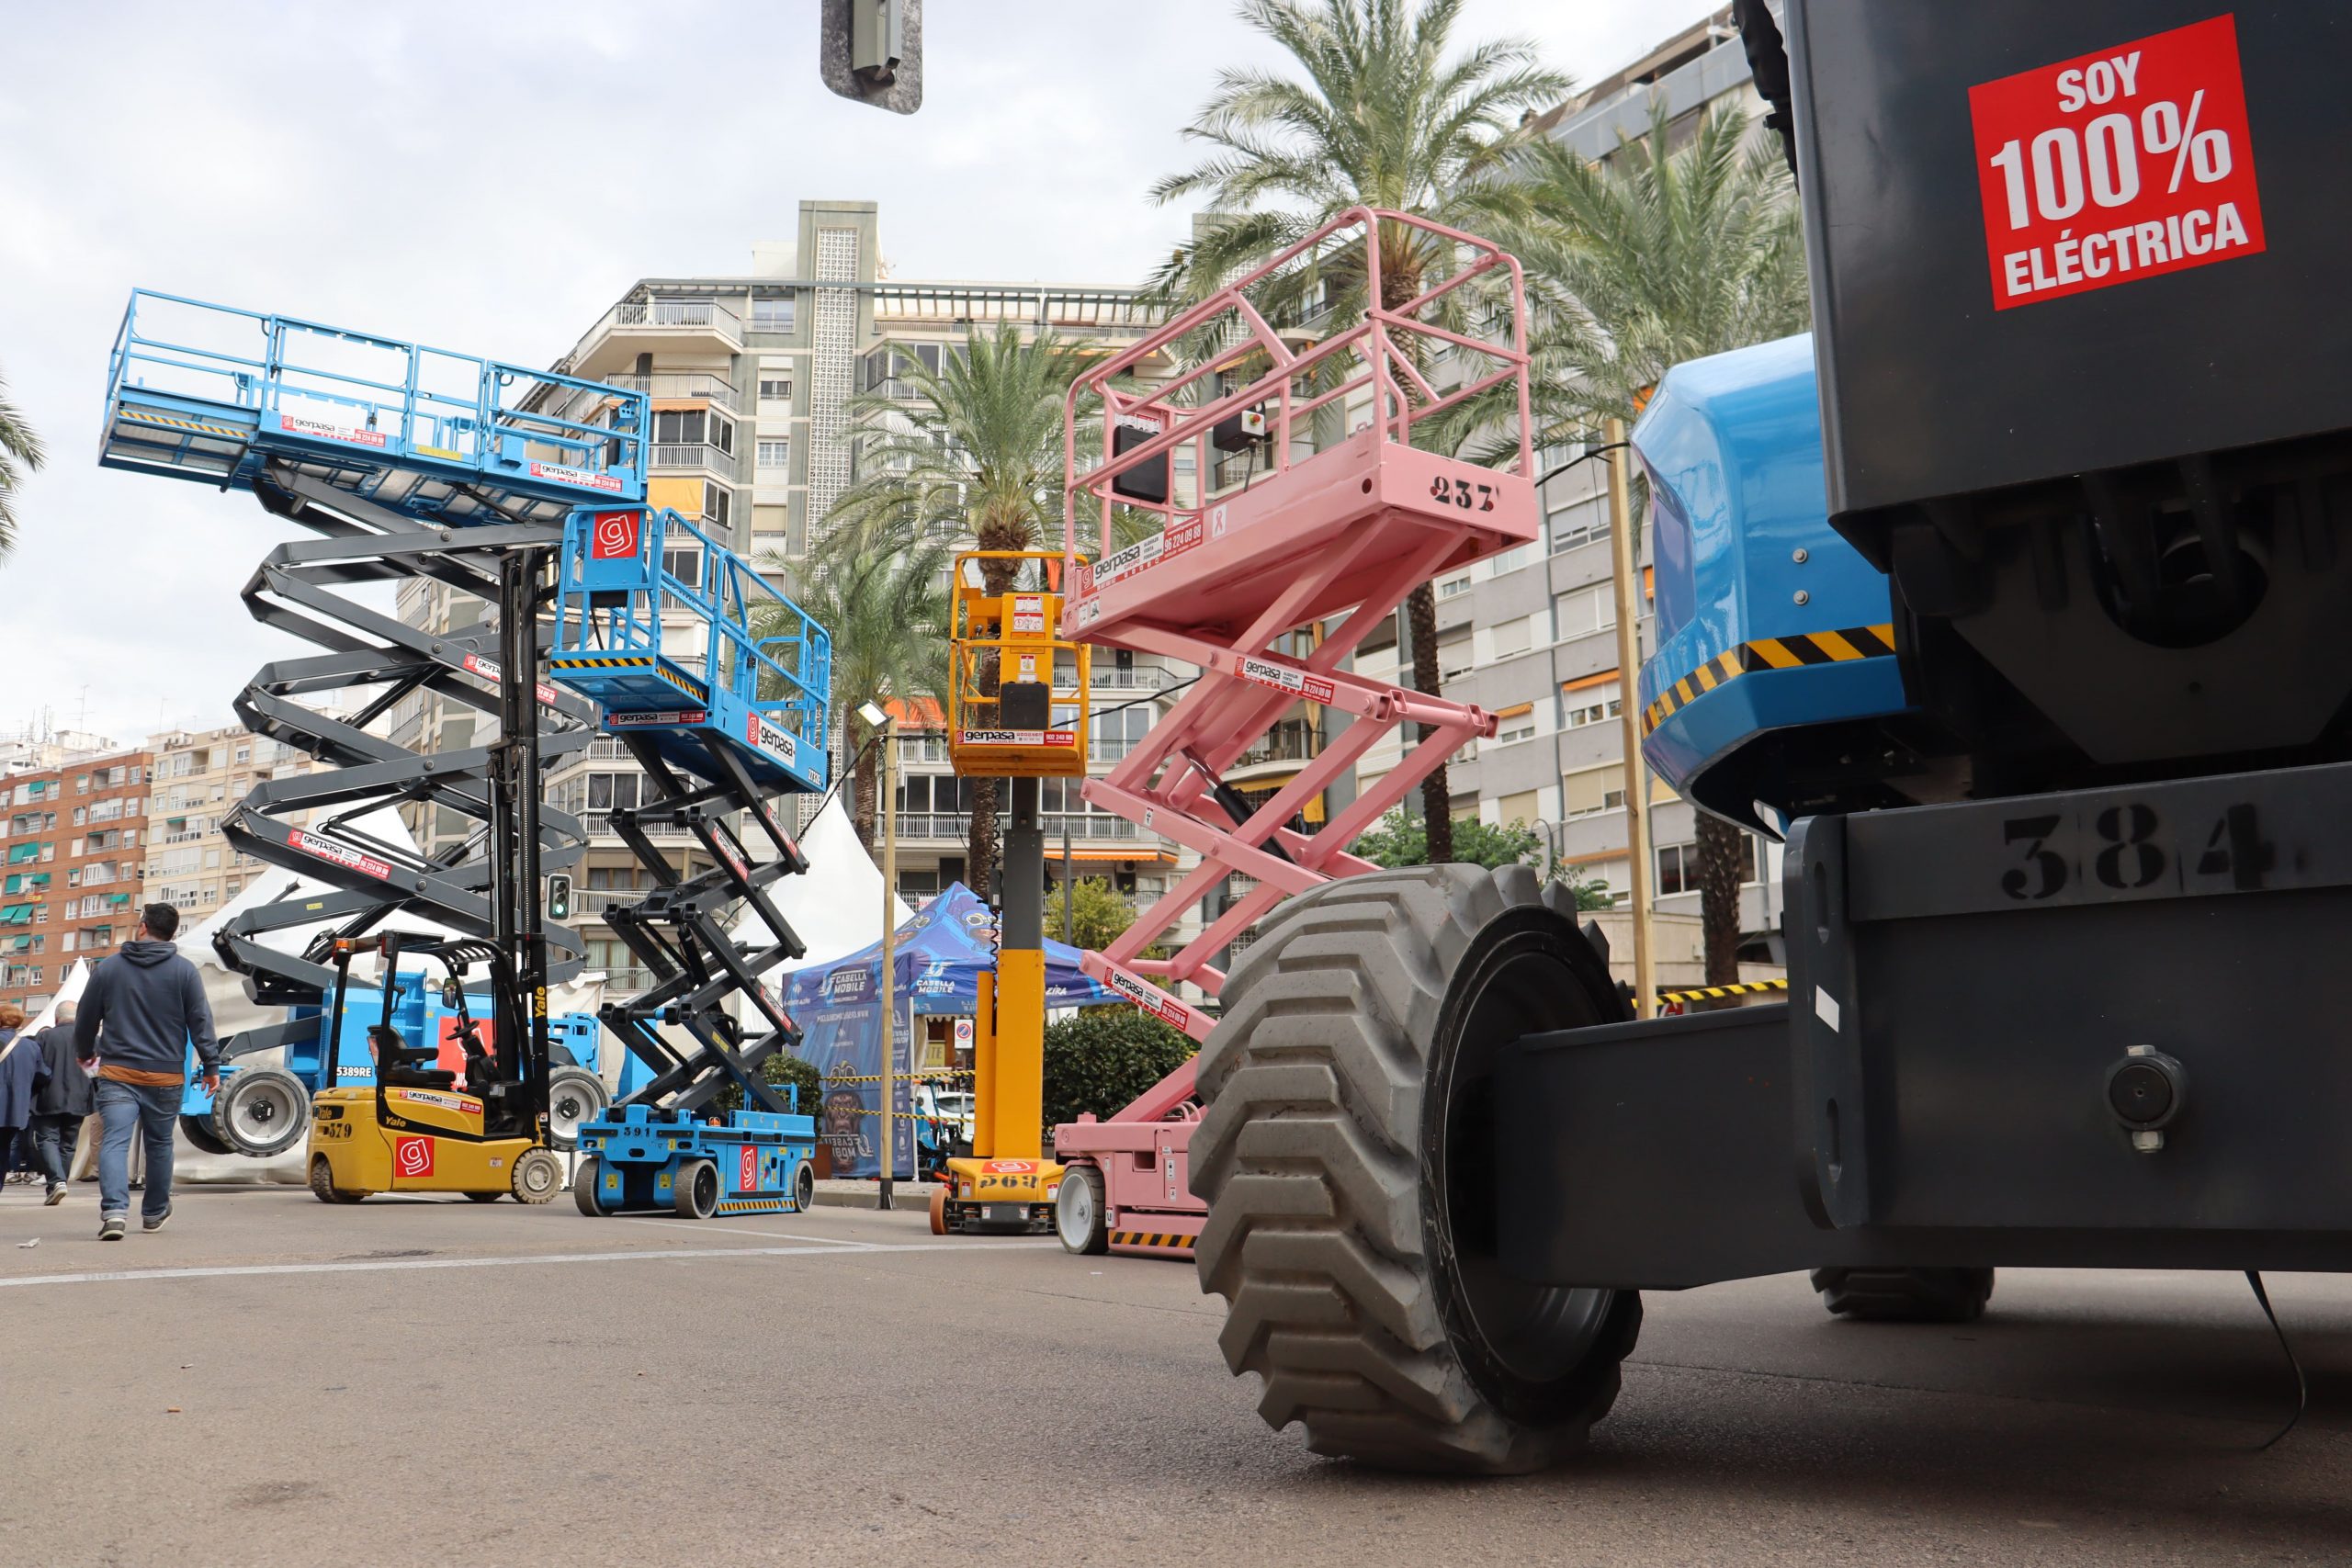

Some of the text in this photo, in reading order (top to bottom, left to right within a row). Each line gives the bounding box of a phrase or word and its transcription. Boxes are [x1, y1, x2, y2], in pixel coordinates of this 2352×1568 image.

[2056, 51, 2141, 113] SOY
[1990, 89, 2233, 231] 100%
[2003, 202, 2249, 297] ELÉCTRICA
[295, 418, 335, 432] gerpasa
[542, 465, 578, 478] gerpasa
[1433, 476, 1492, 512] 237
[1164, 538, 1172, 552] 96
[1172, 534, 1184, 549] 224
[1184, 530, 1193, 542] 09
[1095, 545, 1140, 580] gerpasa
[478, 660, 501, 674] gerp
[1246, 660, 1281, 680] gerpasa
[1309, 684, 1318, 695] 224
[620, 714, 658, 722] gerpasa
[761, 727, 793, 757] gerpasa
[965, 730, 1015, 741] gerpasa
[304, 835, 343, 854] gerpasa
[2002, 803, 2275, 899] 384
[367, 862, 375, 871] 224
[835, 972, 867, 984] CASELLA
[916, 979, 956, 987] CASELLA
[834, 980, 865, 994] MOBILE
[918, 986, 954, 994] MOBILE
[1114, 974, 1144, 997] gerpasa
[535, 986, 546, 1018] Yale
[336, 1066, 372, 1077] 5389RE
[409, 1090, 443, 1103] gerpasa
[318, 1107, 334, 1120] Yale
[385, 1115, 407, 1128] Yale
